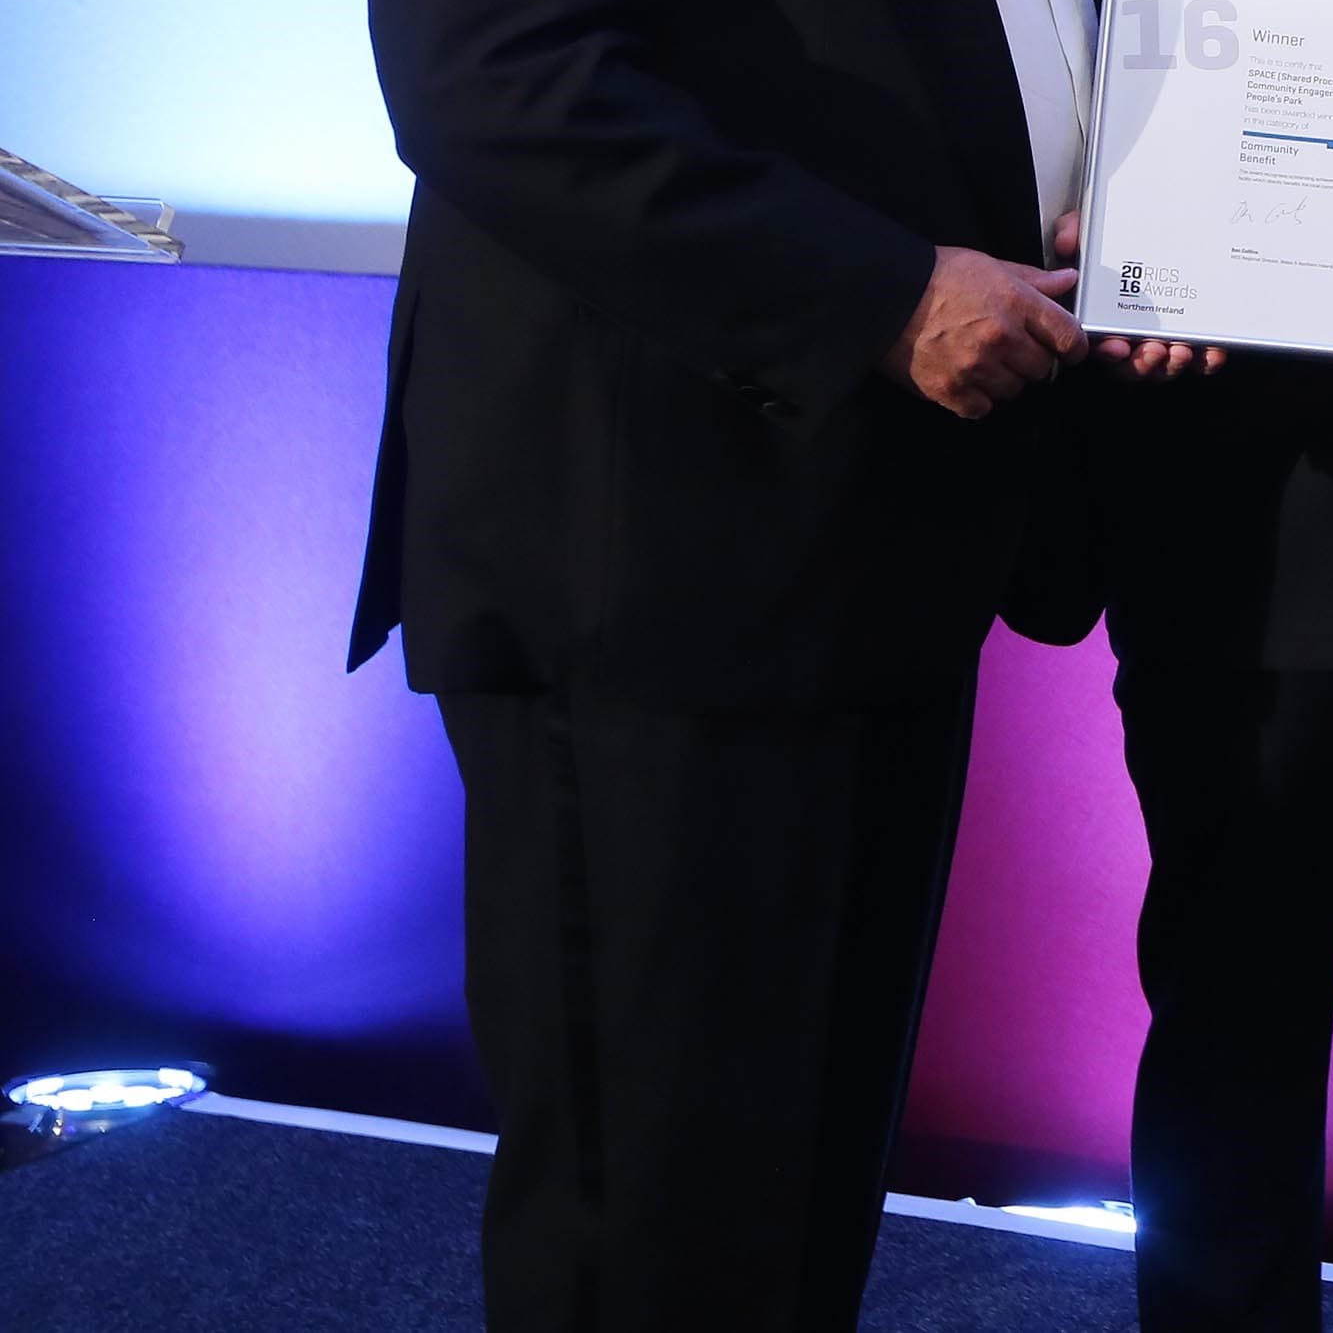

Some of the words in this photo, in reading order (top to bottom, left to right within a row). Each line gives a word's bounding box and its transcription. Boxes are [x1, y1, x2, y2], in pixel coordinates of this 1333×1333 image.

[1252, 28, 1305, 47] Winner
[1248, 68, 1277, 80] SPACE
[1247, 80, 1297, 94] Community
[1246, 91, 1282, 104] People's
[1283, 96, 1303, 106] Park
[1240, 140, 1299, 157] Community
[1239, 152, 1276, 166] Benefit
[1121, 264, 1143, 280] 20
[1143, 266, 1180, 284] RICS
[1119, 279, 1141, 294] 16
[1142, 281, 1198, 300] Awards
[1117, 301, 1155, 313] Northern
[1155, 305, 1185, 315] Ireland
